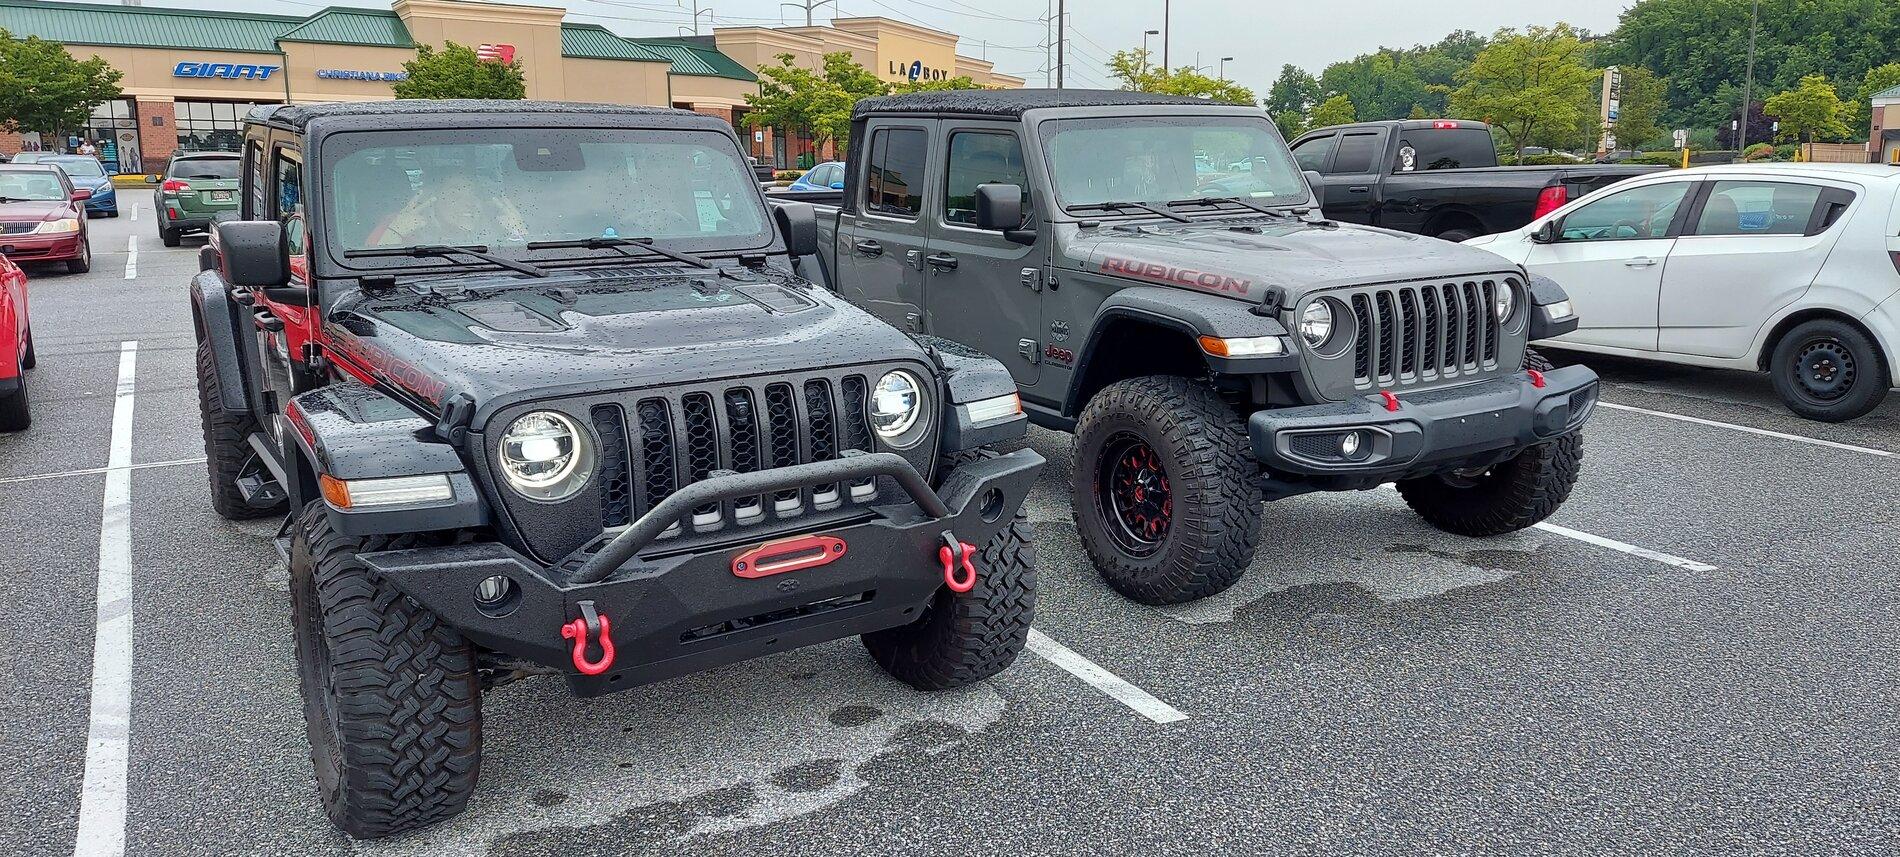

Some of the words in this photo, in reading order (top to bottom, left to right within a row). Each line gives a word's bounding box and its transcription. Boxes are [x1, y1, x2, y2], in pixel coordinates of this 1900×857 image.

[172, 61, 281, 80] GIANT
[316, 69, 380, 81] CHRISTIANA
[1100, 256, 1251, 295] RUBICON
[1044, 341, 1073, 364] Jeep
